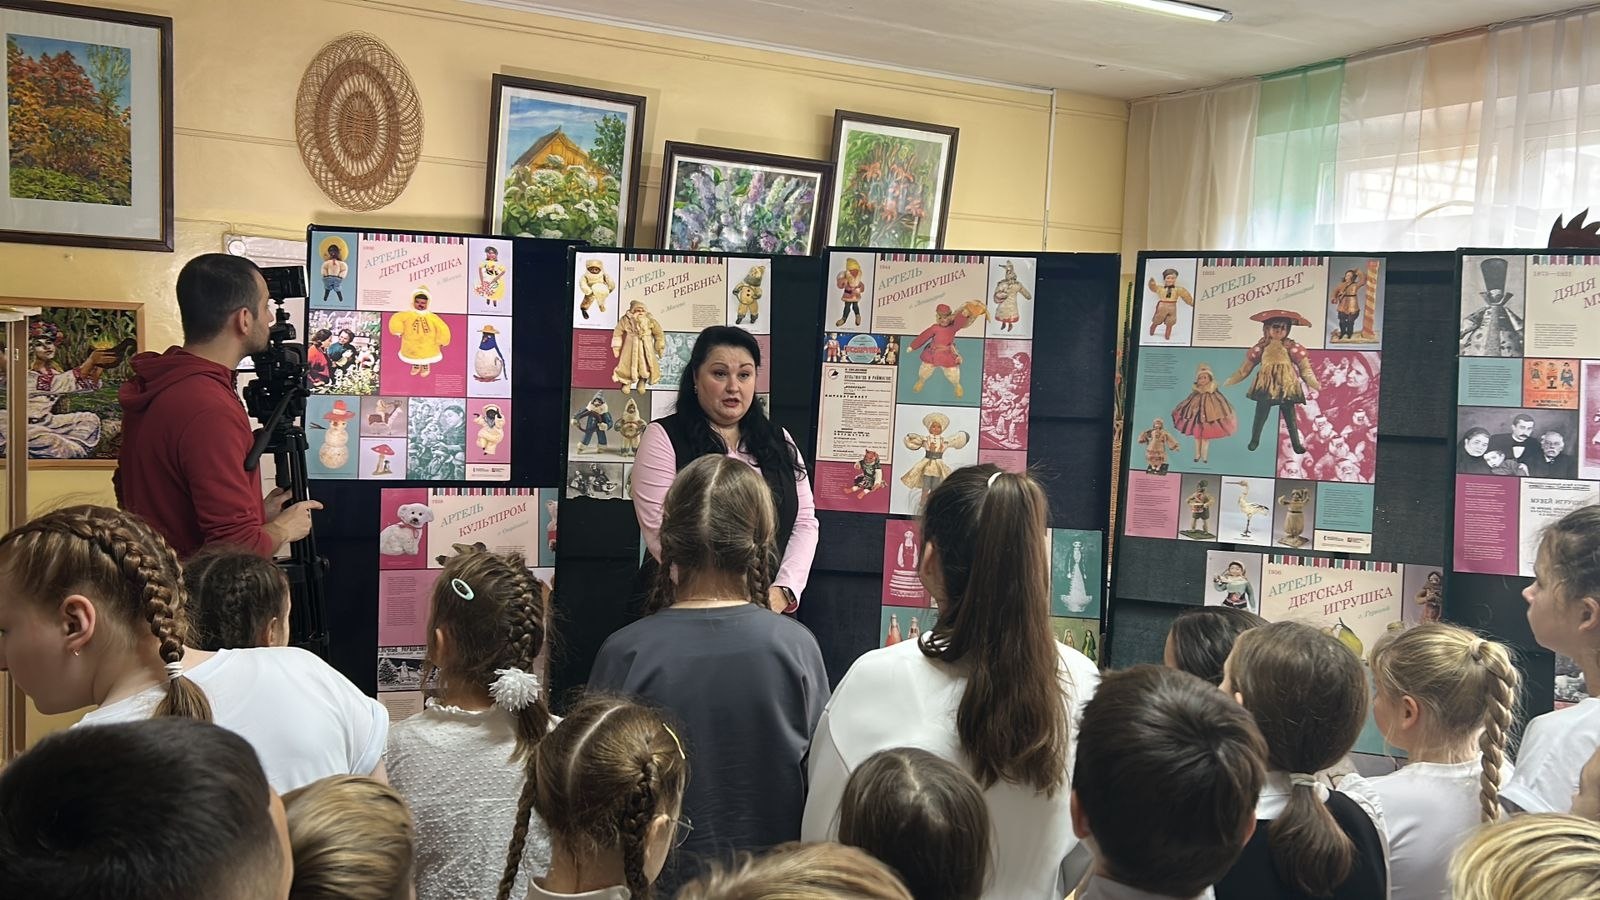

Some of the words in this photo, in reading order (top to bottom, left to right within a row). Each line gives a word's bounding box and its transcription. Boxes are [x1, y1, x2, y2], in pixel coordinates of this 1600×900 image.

[365, 246, 408, 268] АРТЕЛЬ
[380, 254, 430, 278] ДЕТСКАЯ
[409, 258, 462, 281] ИГРУШКА
[623, 268, 666, 290] АРТЕЛЬ
[878, 267, 923, 290] АРТЕЛЬ
[644, 281, 665, 296] ВСЕ
[666, 272, 690, 289] ДЛЯ
[673, 274, 723, 298] РЕБЕНКА
[877, 269, 966, 307] ПРОМИГРУШКА
[1200, 272, 1256, 301] АРТЕЛЬ
[1226, 271, 1304, 309] ИЗОКУЛЬТ
[1552, 277, 1596, 303] ДЯДЯ
[1583, 292, 1600, 309] МУ
[440, 503, 484, 527] АРТЕЛЬ
[458, 502, 527, 538] КУЛЬТПРОМ
[1268, 573, 1323, 597] АРТЕЛЬ
[1288, 580, 1353, 610] ДЕТСКАЯ
[1323, 586, 1392, 615] ИГРУШКА
